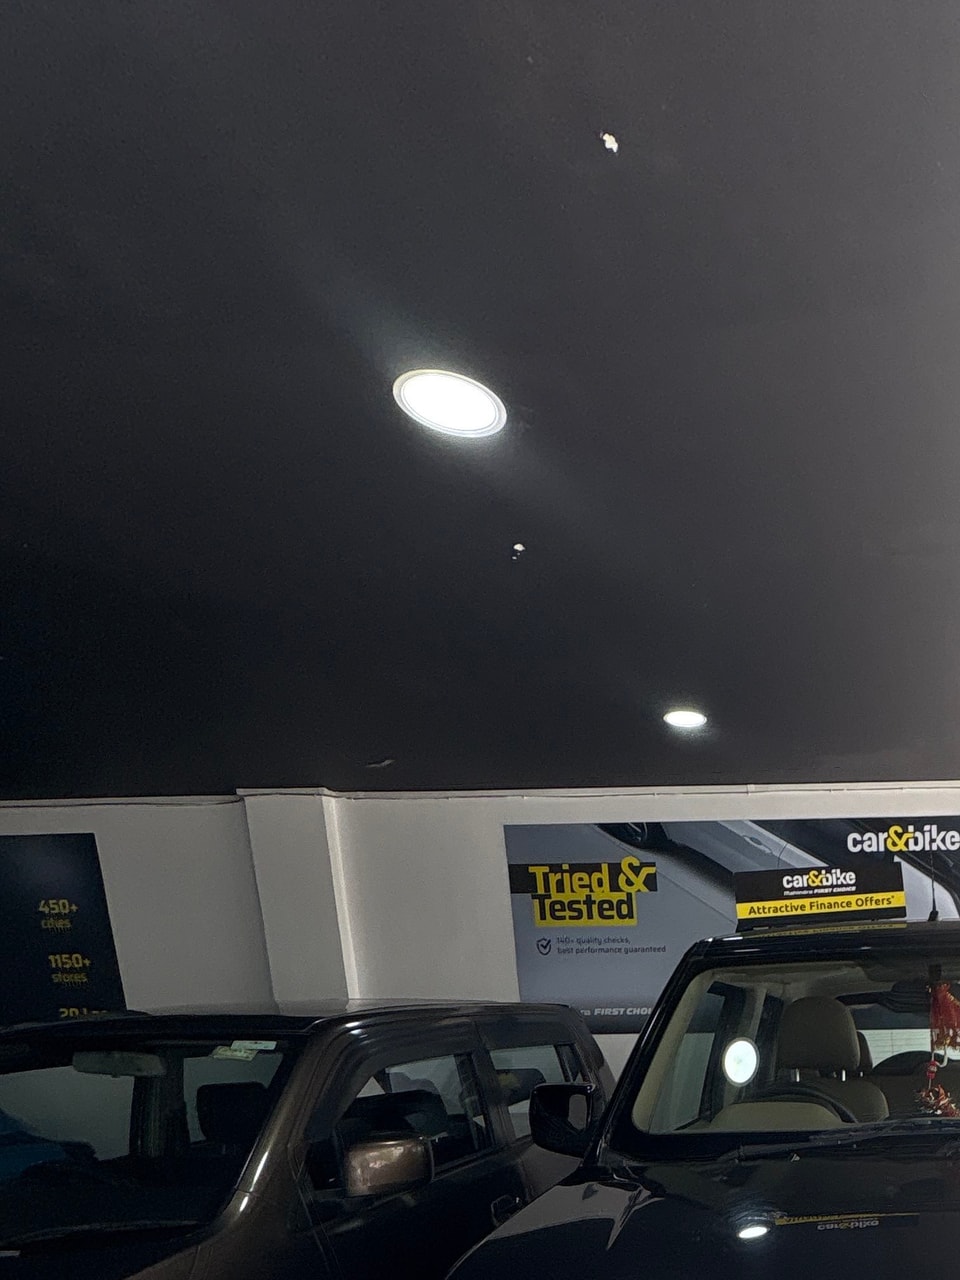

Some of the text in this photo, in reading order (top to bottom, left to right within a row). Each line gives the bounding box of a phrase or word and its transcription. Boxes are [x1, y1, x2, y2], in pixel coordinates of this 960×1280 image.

[847, 825, 960, 852] car&bike
[528, 855, 657, 893] Tried &
[782, 869, 856, 889] car&bike
[38, 899, 79, 914] 450+
[531, 892, 635, 921] Tested
[748, 901, 806, 916] Attractive
[809, 900, 853, 911] Finance
[576, 937, 602, 946] quality
[557, 945, 667, 955] best performance guaranteed
[48, 953, 92, 969] 1150+
[51, 971, 88, 983] stores
[593, 1007, 625, 1016] FIRST
